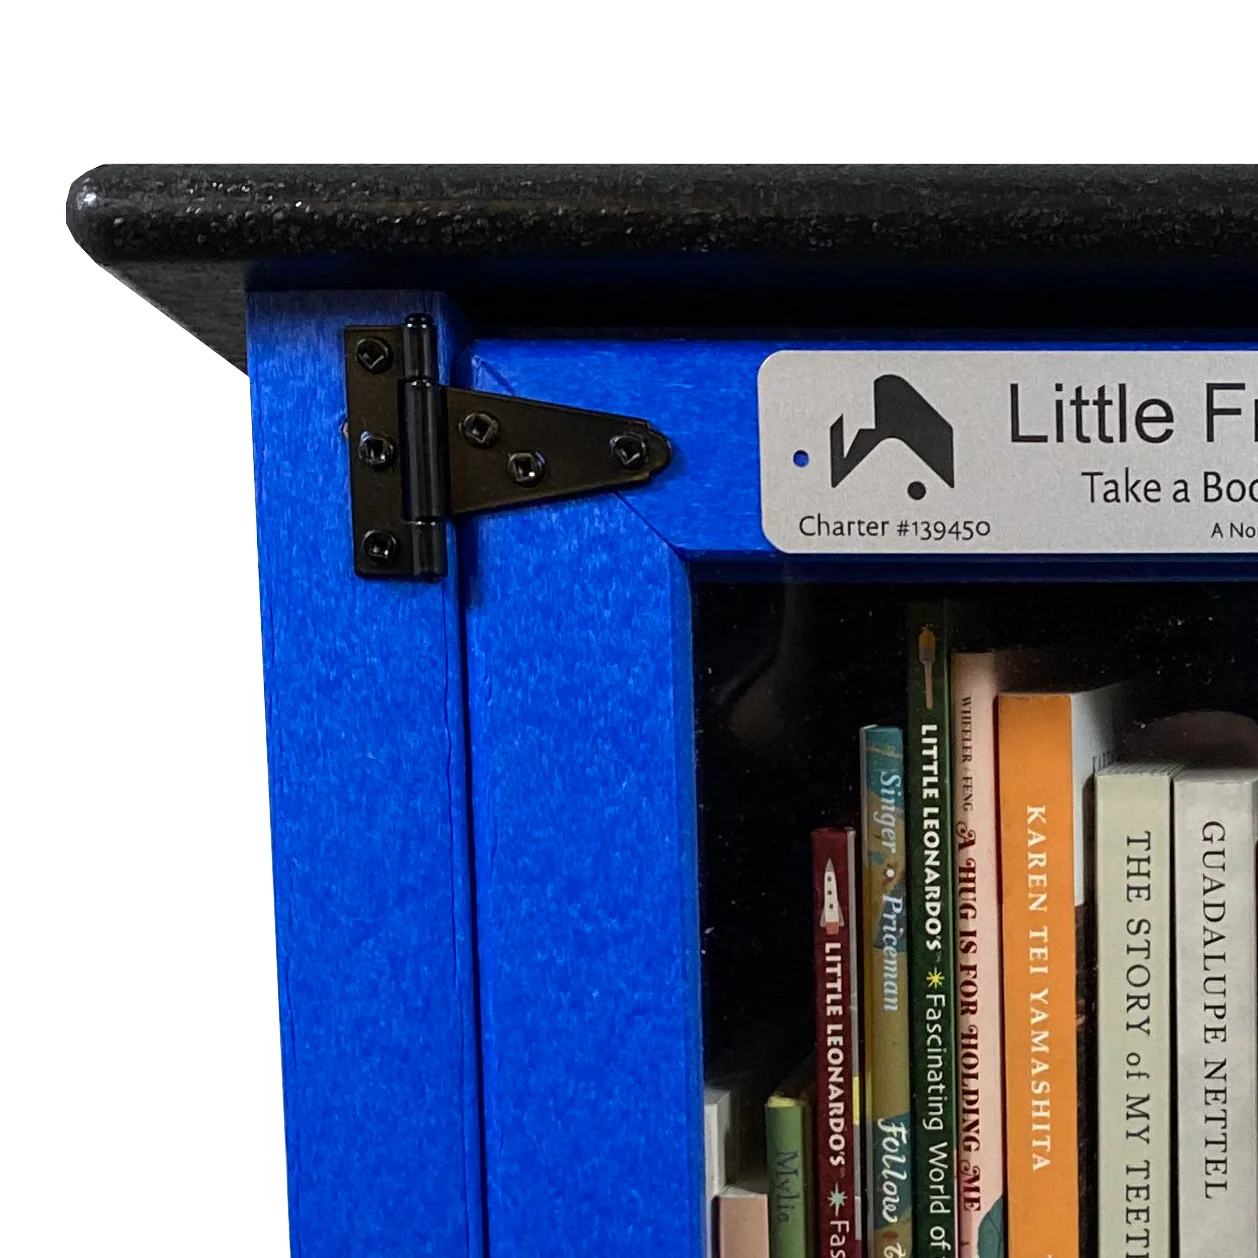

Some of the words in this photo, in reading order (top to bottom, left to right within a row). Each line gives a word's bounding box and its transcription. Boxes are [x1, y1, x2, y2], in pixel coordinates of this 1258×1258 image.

[1008, 381, 1176, 445] Little
[1082, 470, 1163, 505] Take
[1173, 479, 1190, 504] a
[799, 514, 891, 538] Charter
[896, 516, 991, 542] #139450
[1210, 522, 1224, 539] A
[921, 724, 938, 799] LITTLE
[960, 696, 972, 763] WHEELER
[873, 771, 902, 854] Singer
[962, 777, 973, 812] FENG
[955, 822, 976, 849] A
[1026, 805, 1048, 912] KAREN
[1126, 831, 1152, 903] THE
[957, 858, 977, 919] HUG
[879, 895, 902, 1011] Priceman
[958, 927, 978, 954] IS
[1029, 926, 1049, 974] TEI
[1201, 820, 1227, 1044] GUADALUPE
[824, 942, 843, 1017] LITTLE
[958, 964, 978, 1016] FOR
[1126, 918, 1151, 1037] STORY
[922, 993, 945, 1131] Fascinating
[959, 1024, 981, 1152] HOLDING
[1028, 988, 1051, 1172] YAMASHITA
[1125, 1051, 1150, 1079] of
[1125, 1093, 1150, 1144] MY
[1203, 1058, 1228, 1199] NETTEL
[878, 1117, 908, 1223] Follow
[926, 1142, 950, 1214] World
[960, 1160, 981, 1213] ME
[930, 1226, 951, 1249] of
